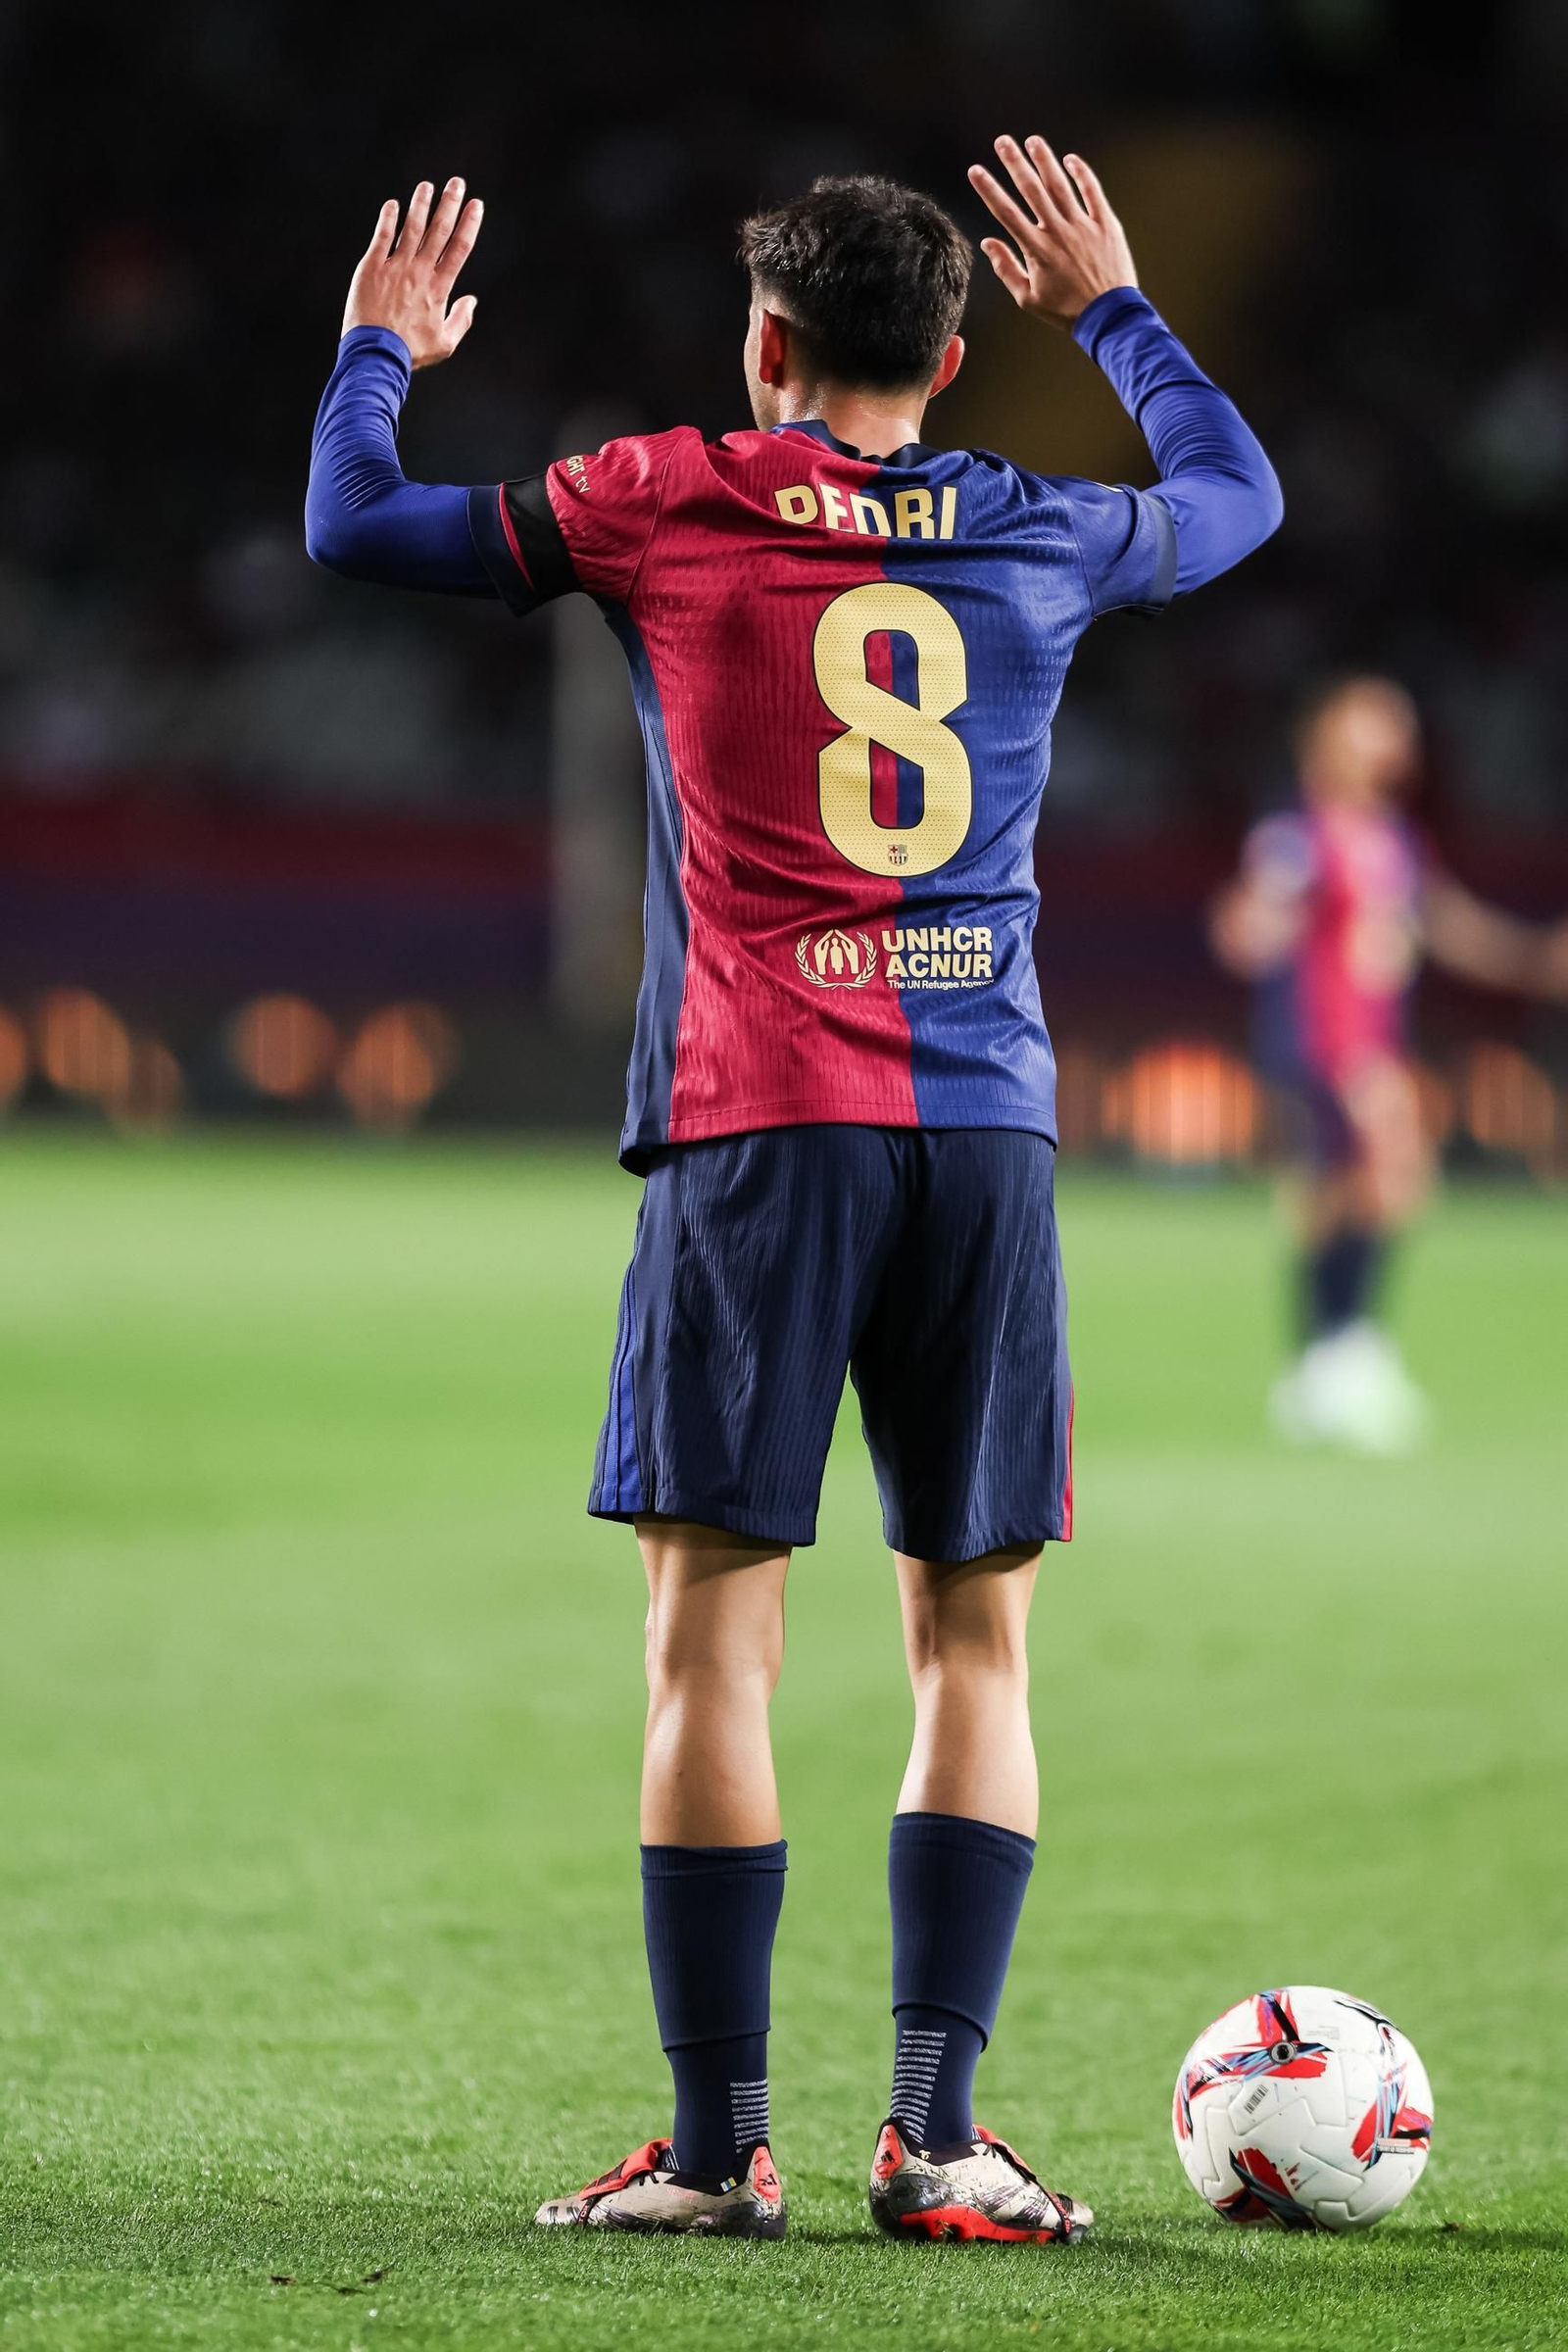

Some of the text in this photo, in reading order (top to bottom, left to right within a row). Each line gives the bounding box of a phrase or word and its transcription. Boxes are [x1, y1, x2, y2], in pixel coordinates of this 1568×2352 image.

[774, 483, 957, 540] PEDRI
[812, 582, 973, 877] 8
[881, 927, 993, 952] UNHCR
[885, 954, 993, 978] ACNUR
[887, 980, 906, 989] The
[922, 981, 959, 991] Refugee
